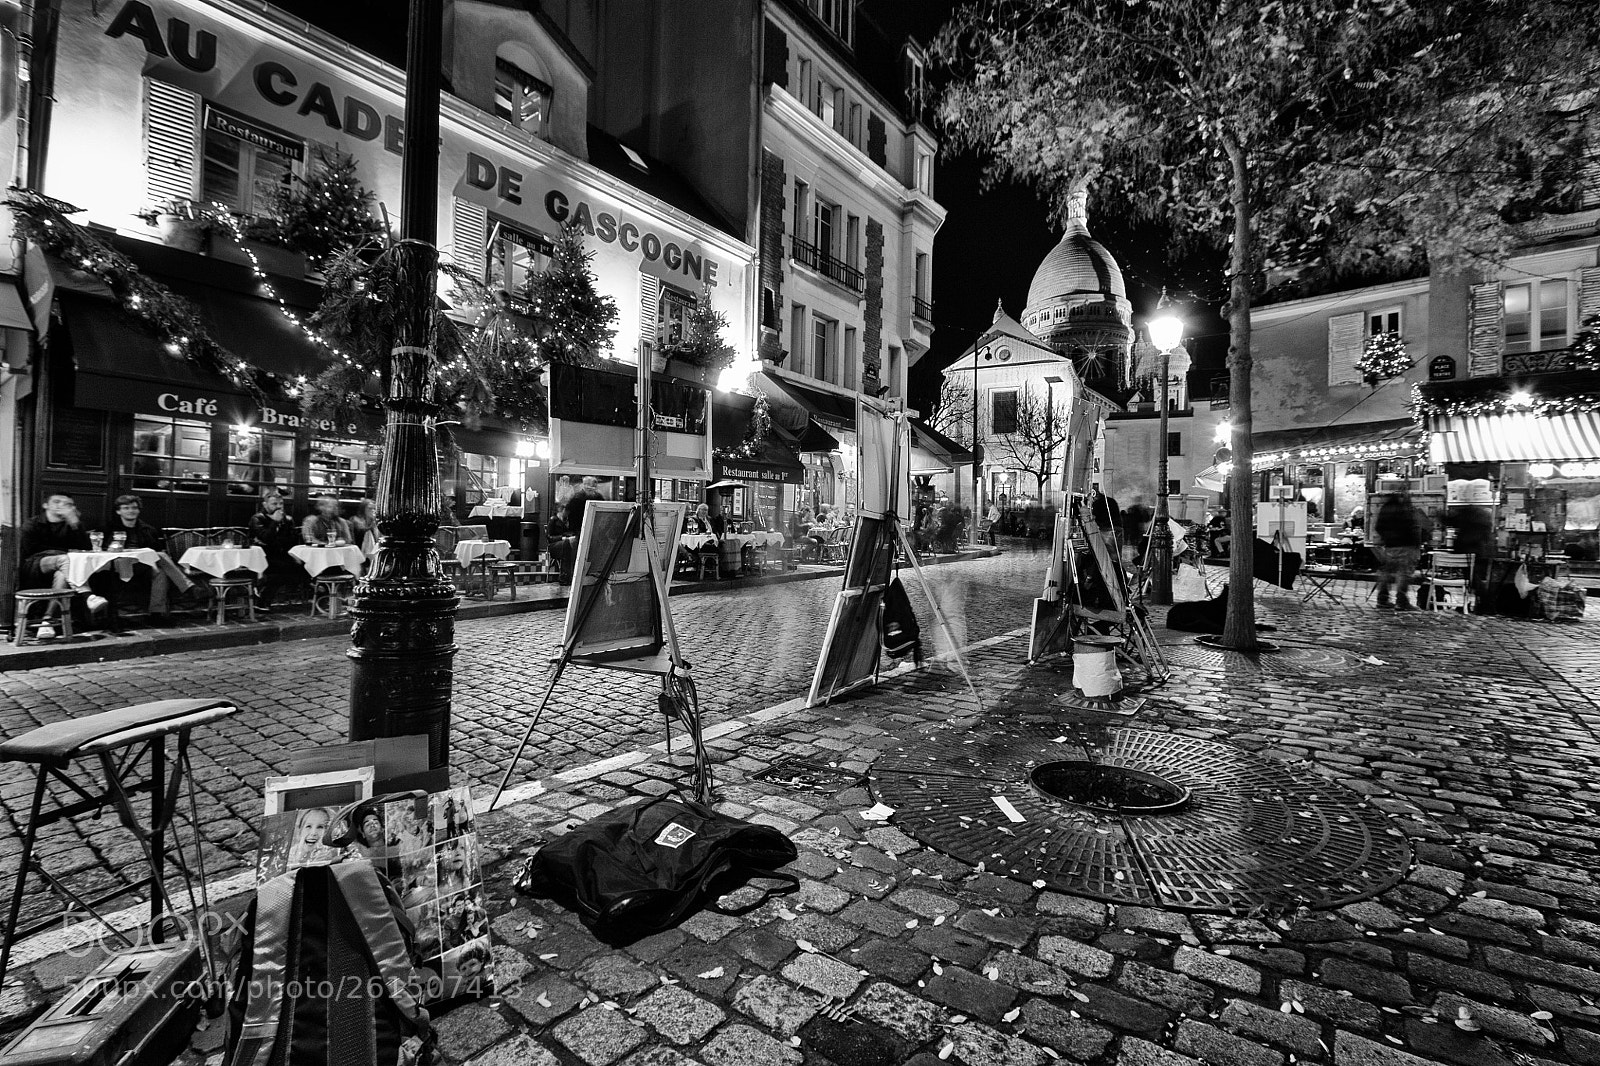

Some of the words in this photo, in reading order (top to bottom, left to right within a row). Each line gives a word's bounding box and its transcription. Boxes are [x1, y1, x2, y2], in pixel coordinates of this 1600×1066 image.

[104, 0, 217, 73] AU
[253, 61, 405, 158] CADE
[467, 152, 522, 206] DE
[544, 189, 719, 288] GASCOGNE
[215, 116, 299, 159] Restaurant
[503, 231, 524, 245] salle
[526, 241, 536, 250] au
[157, 393, 218, 416] Café
[1363, 451, 1397, 459] COCKTAILS
[722, 465, 759, 479] Restaurant
[761, 470, 774, 480] salle
